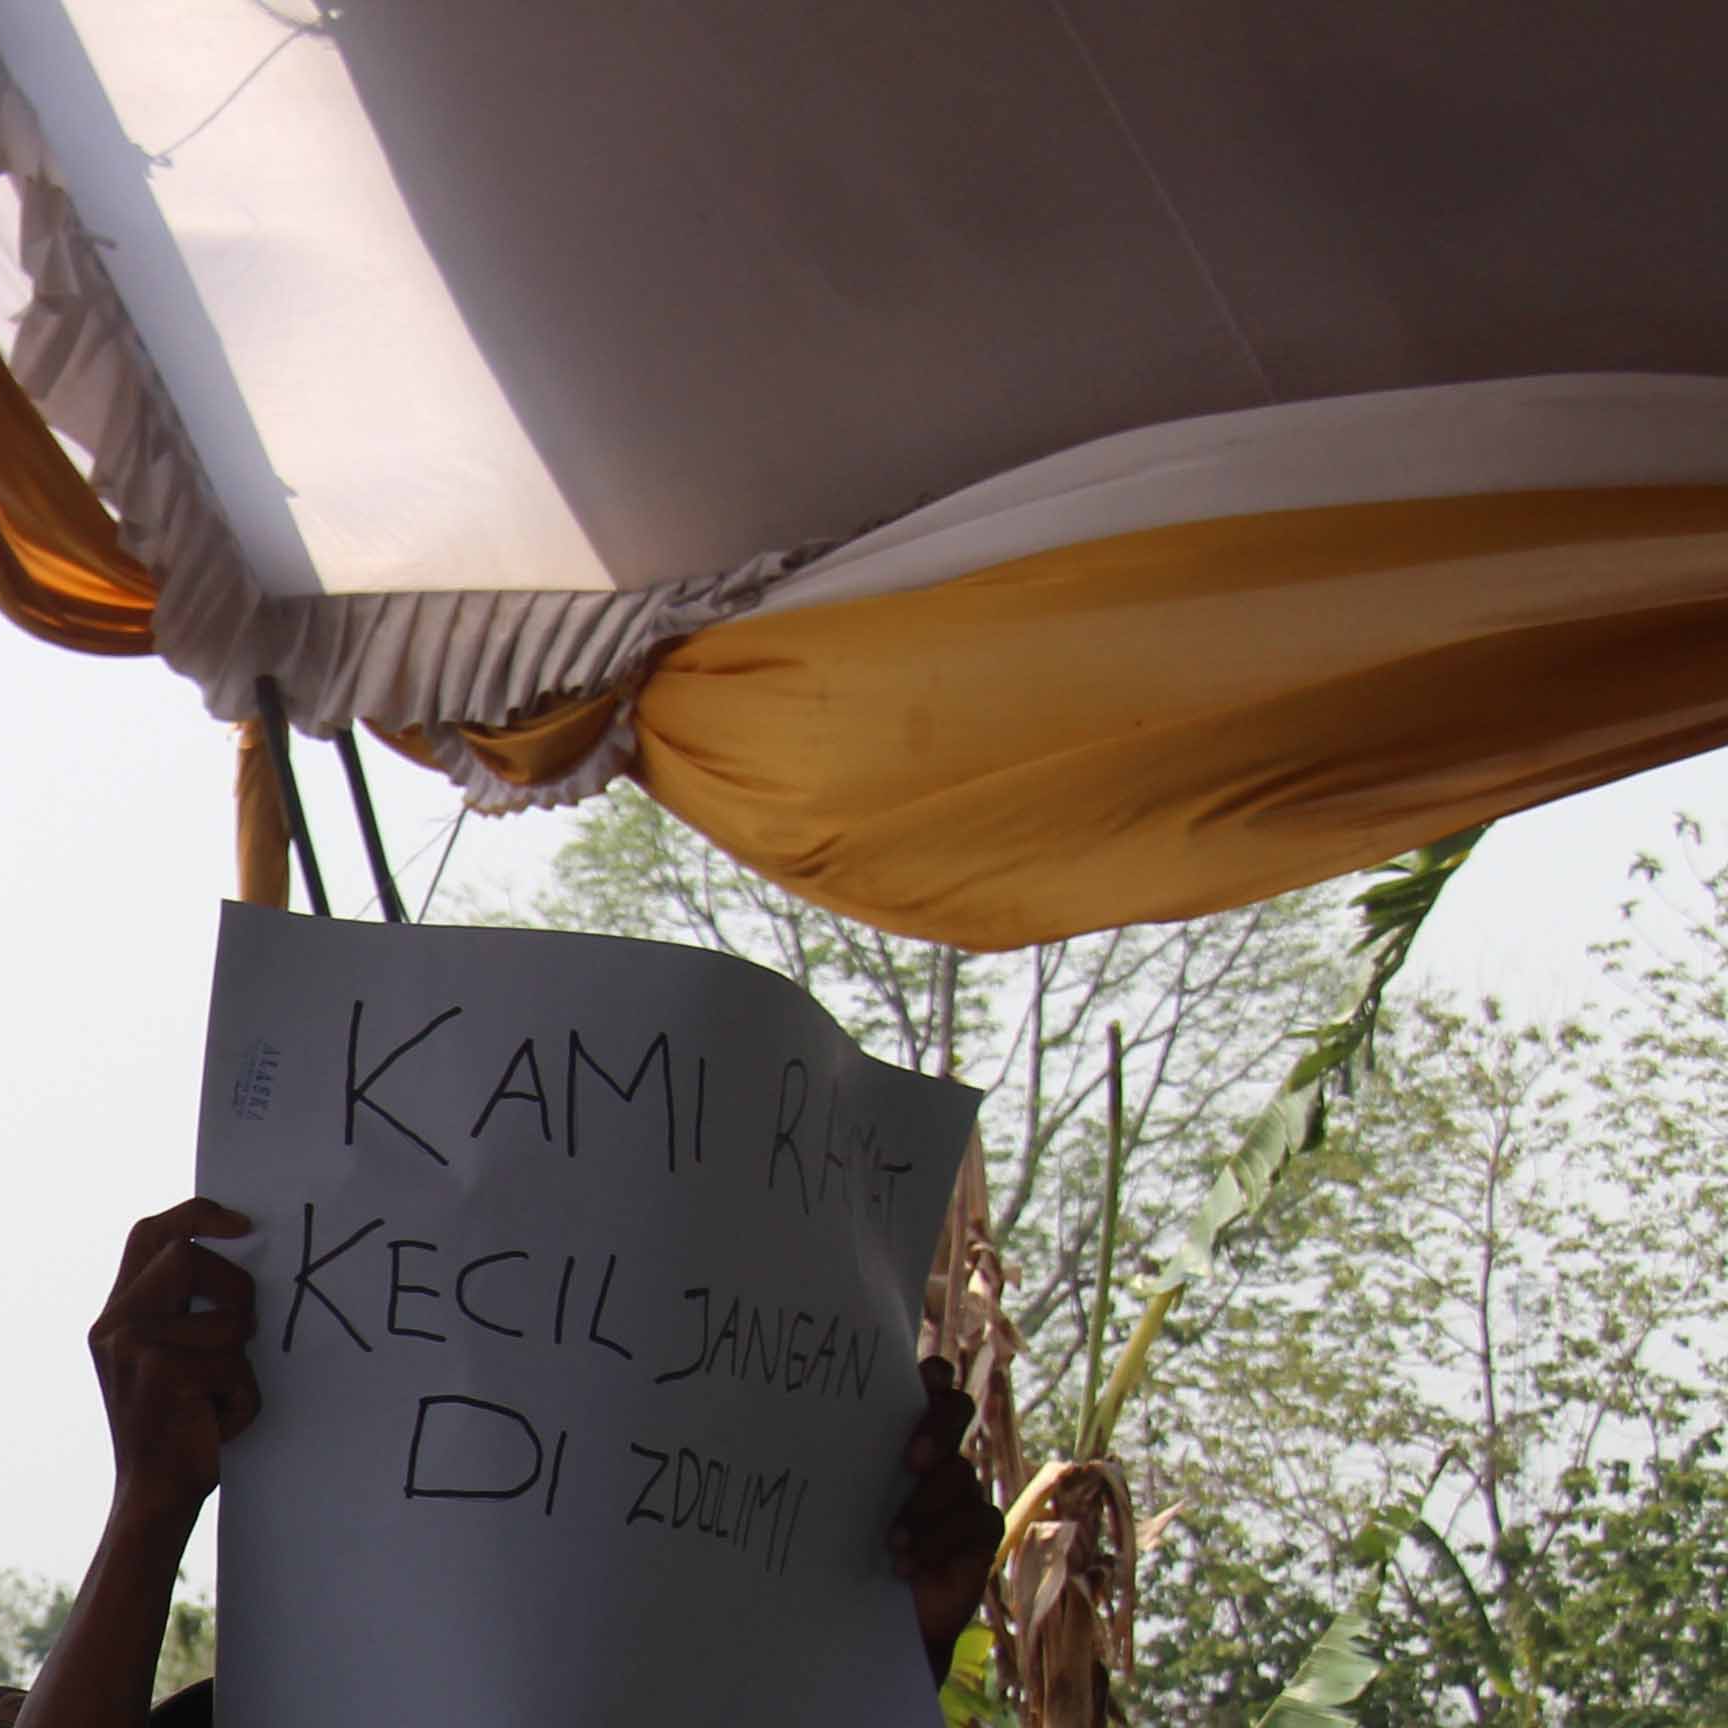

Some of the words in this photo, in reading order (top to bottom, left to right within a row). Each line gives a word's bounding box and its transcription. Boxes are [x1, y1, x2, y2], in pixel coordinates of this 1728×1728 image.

[342, 999, 708, 1172] KAMI
[281, 1200, 634, 1361] KECIL
[654, 1286, 881, 1401] JANGAN
[404, 1394, 568, 1518] DI
